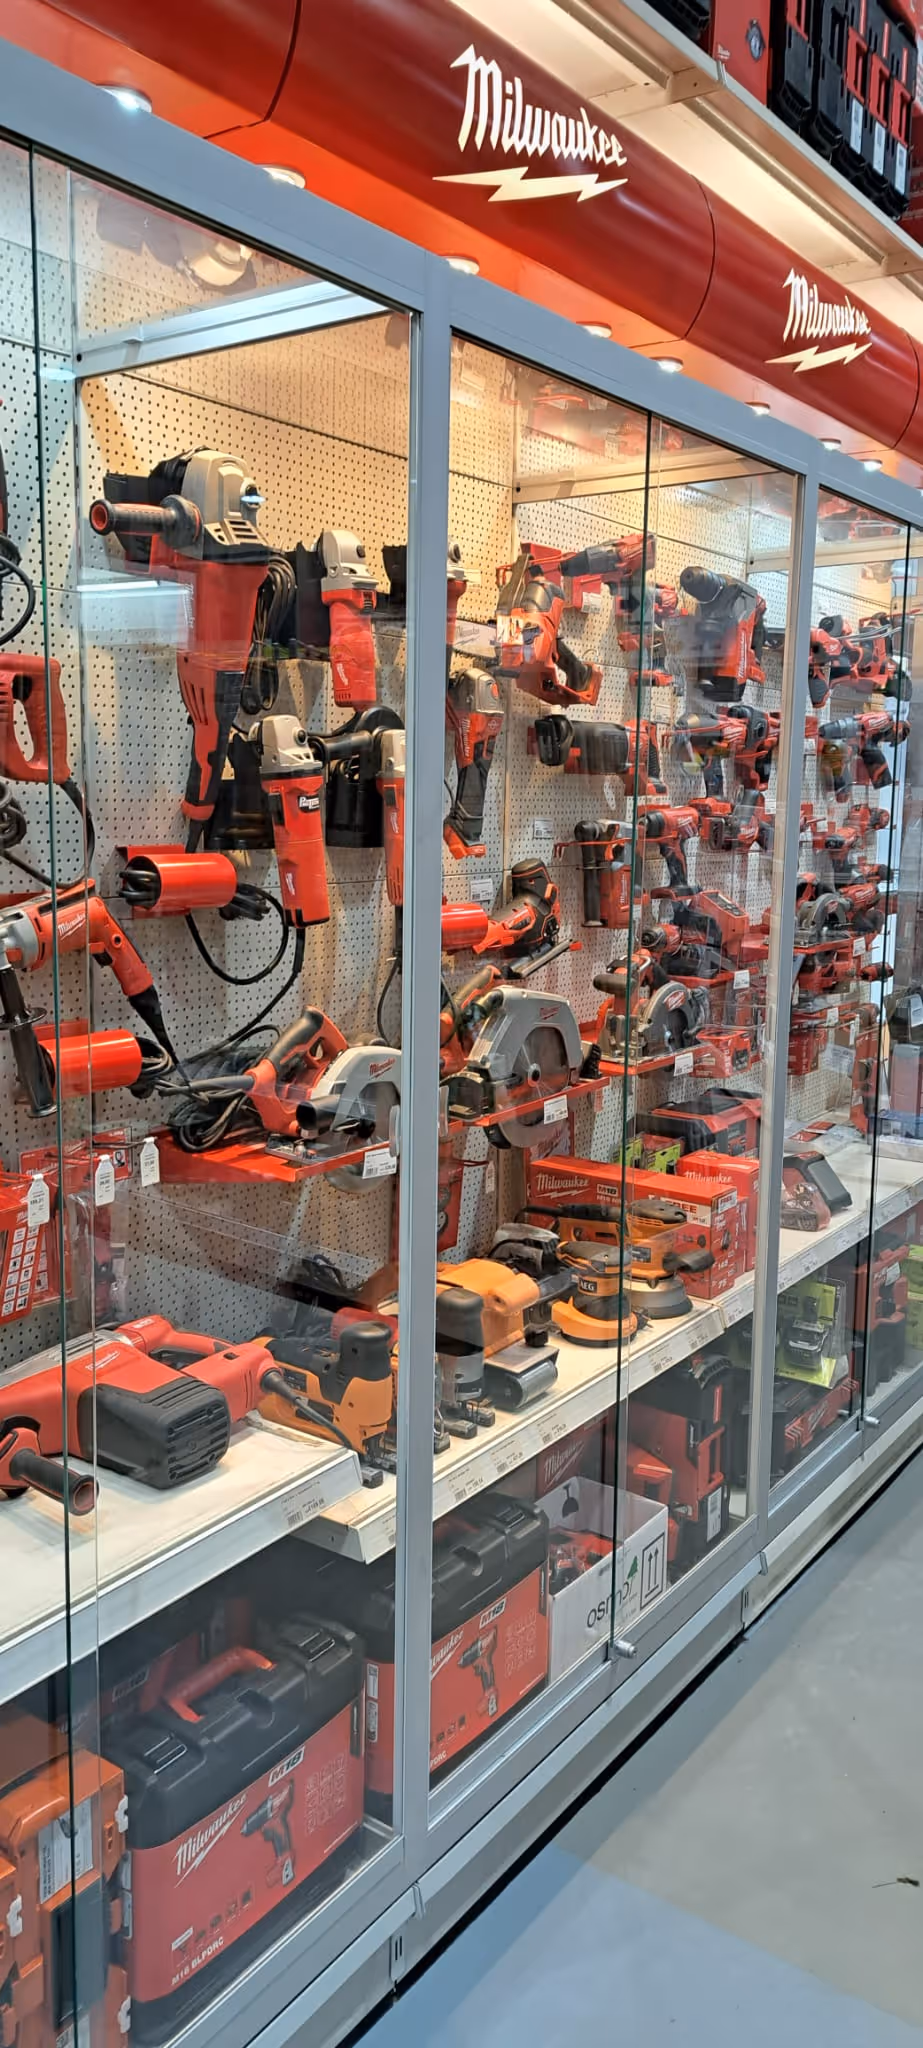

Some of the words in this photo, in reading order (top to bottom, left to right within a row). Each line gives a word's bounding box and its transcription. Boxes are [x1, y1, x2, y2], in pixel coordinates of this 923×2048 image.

[450, 44, 627, 166] Milwaukee
[536, 1171, 589, 1191] Milwaukee
[270, 1751, 301, 1783] M18
[172, 1793, 247, 1876] Milwaukee
